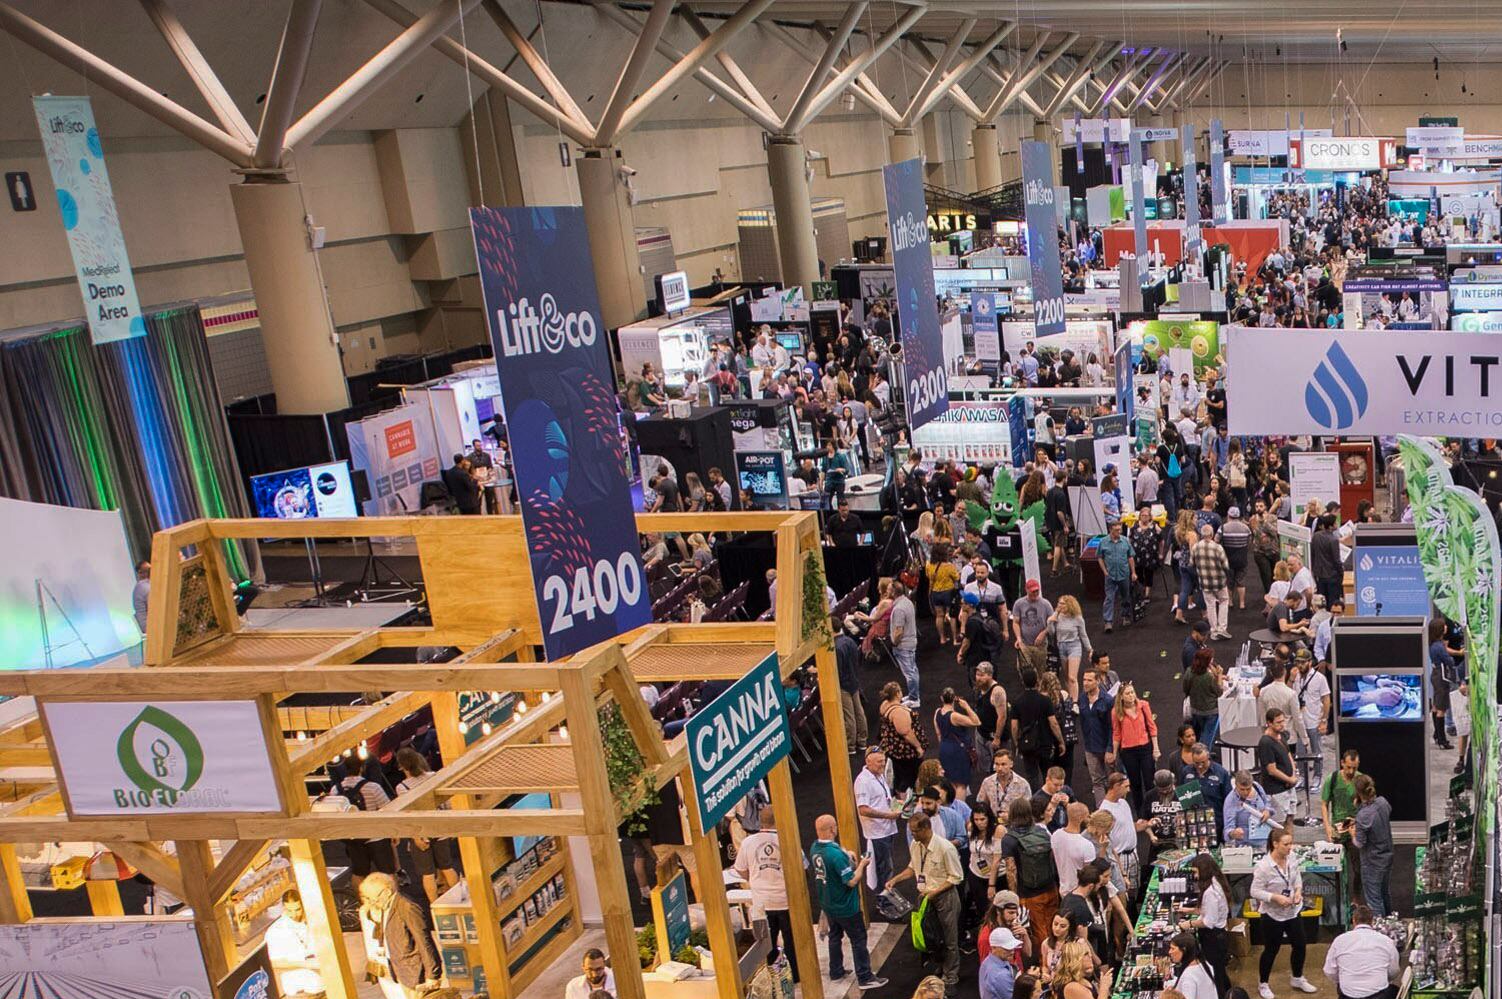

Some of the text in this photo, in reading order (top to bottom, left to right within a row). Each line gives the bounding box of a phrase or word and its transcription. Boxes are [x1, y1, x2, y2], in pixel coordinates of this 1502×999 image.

[1311, 143, 1371, 156] CRONOS
[892, 212, 927, 251] Lift&co
[87, 282, 126, 300] Demo
[98, 304, 129, 321] Area
[497, 292, 597, 357] Lift&co
[1035, 298, 1064, 327] 2200
[909, 365, 948, 414] 2300
[542, 551, 642, 635] 2400
[696, 670, 782, 771] CANNA
